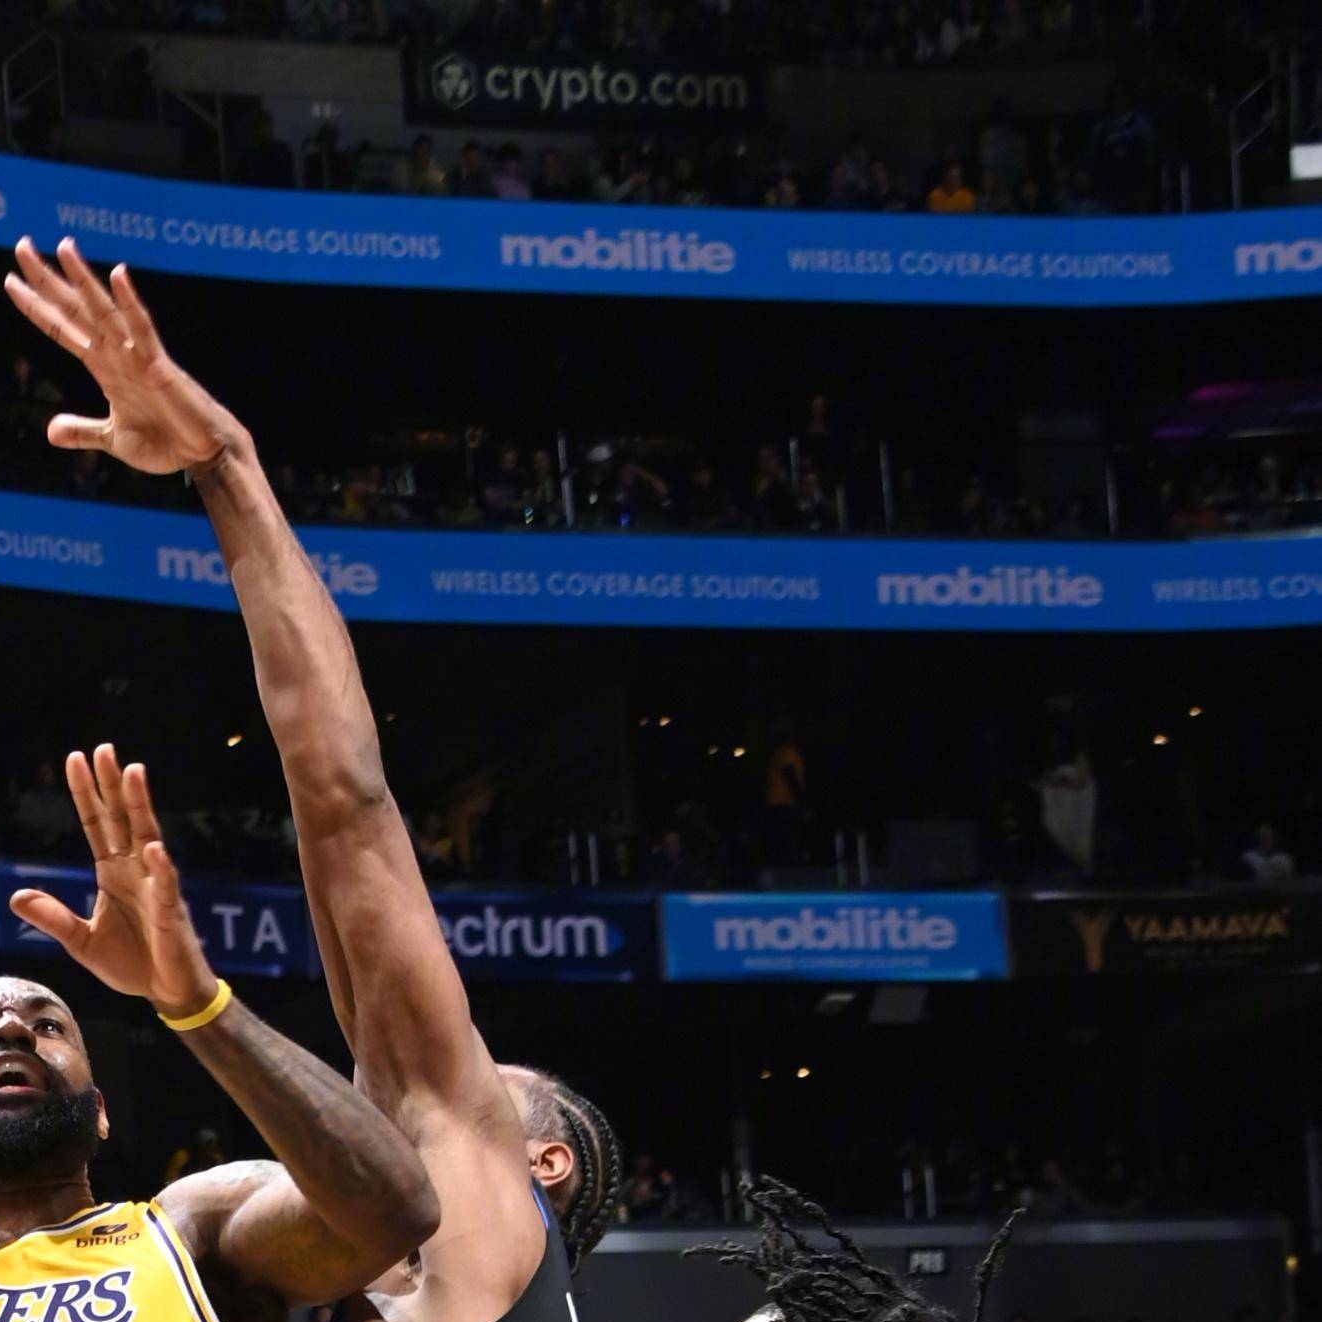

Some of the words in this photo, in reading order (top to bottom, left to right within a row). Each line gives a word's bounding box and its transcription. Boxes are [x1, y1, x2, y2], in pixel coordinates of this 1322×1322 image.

[484, 62, 749, 111] crypto.com
[57, 203, 156, 241] WIRELESS
[163, 216, 299, 254] COVERAGE
[306, 230, 441, 261] SOLUTIONS
[500, 229, 735, 275] mobilitie
[787, 246, 892, 276] WIRELESS
[900, 248, 1033, 278] COVERAGE
[1040, 250, 1172, 279] SOLUTIONS
[431, 569, 540, 596] WIRELESS
[547, 570, 683, 599] COVERAGE
[690, 574, 819, 602] SOLUTIONS
[876, 565, 1103, 607] mobilitie
[1151, 576, 1260, 602] WIRELESS
[714, 906, 959, 951] mobilitie
[75, 1231, 141, 1250] bibigo
